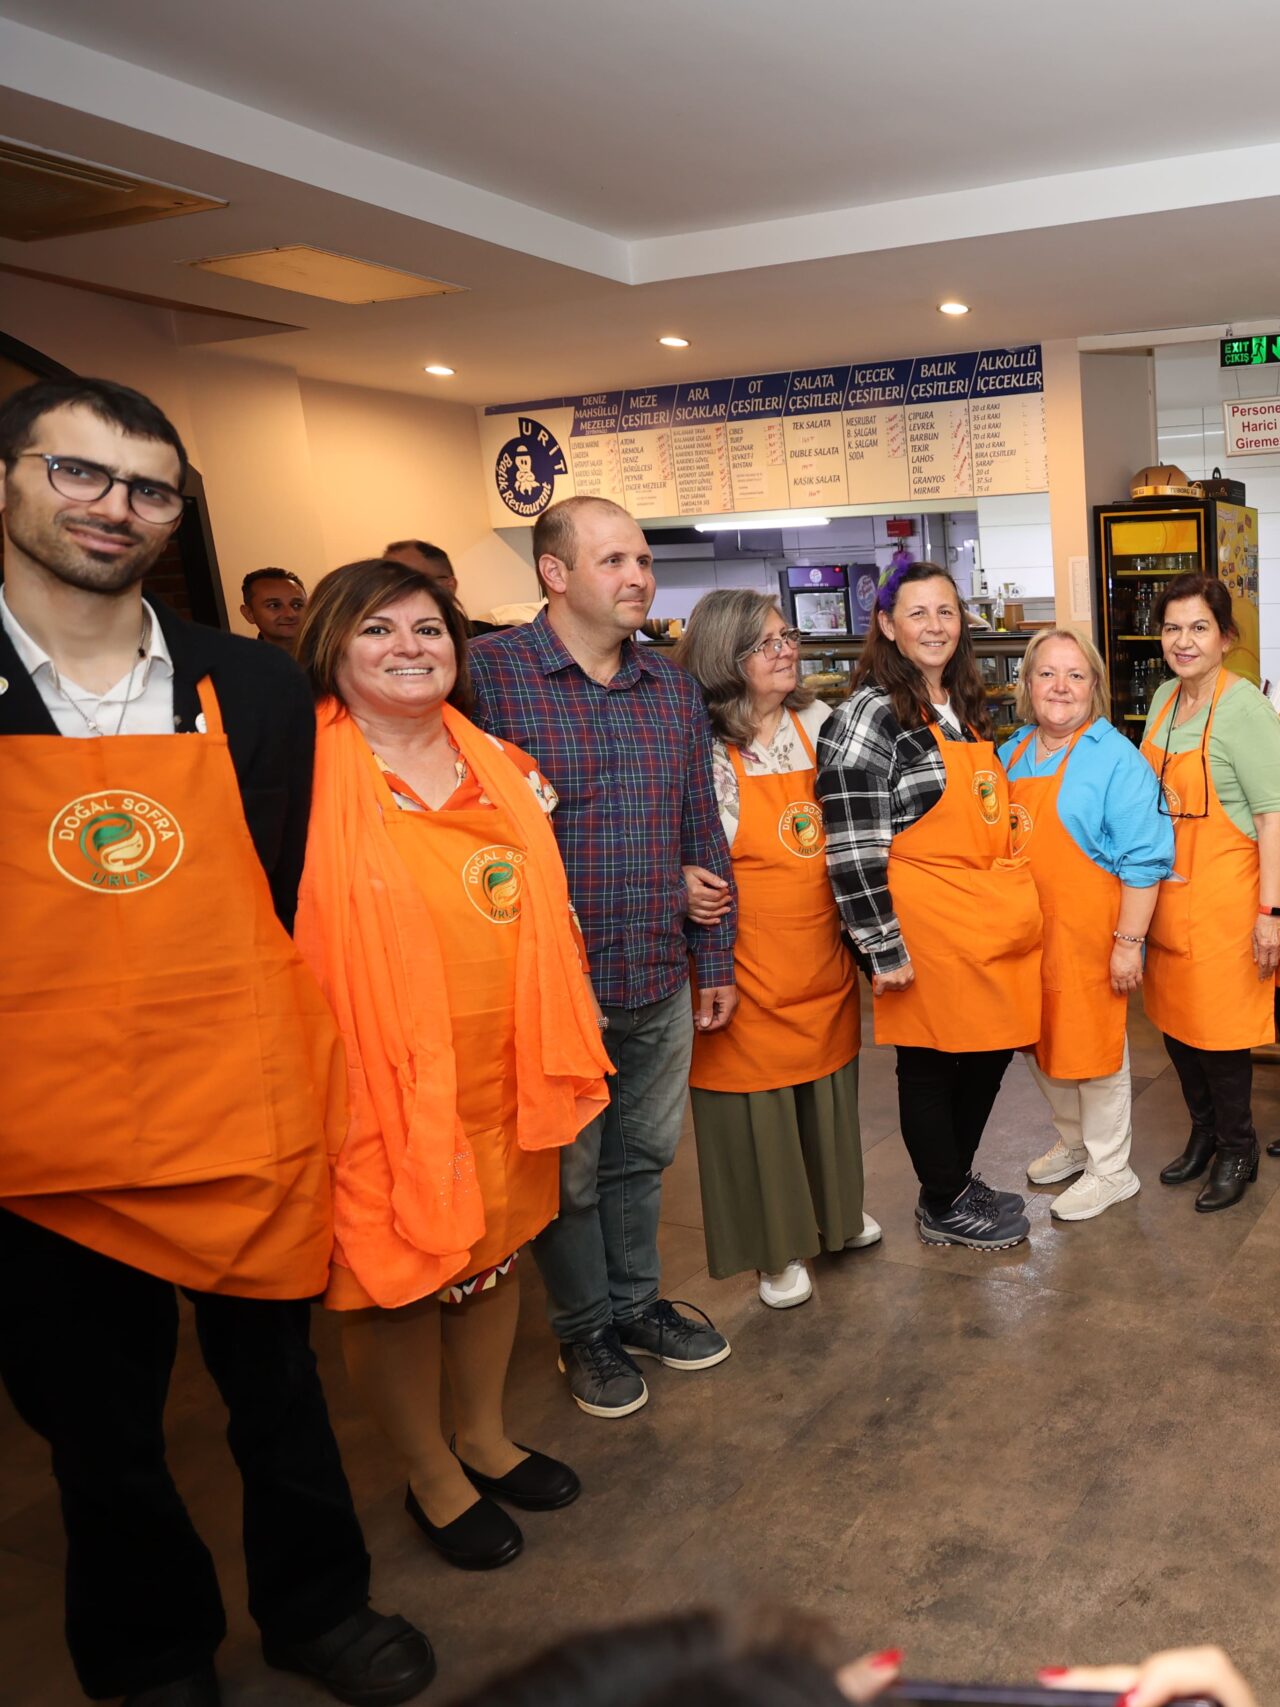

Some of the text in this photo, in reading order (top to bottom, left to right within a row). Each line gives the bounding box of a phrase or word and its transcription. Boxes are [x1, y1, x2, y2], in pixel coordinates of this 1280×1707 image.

[1225, 341, 1249, 353] EXIT
[979, 349, 1036, 372] ALKOLLÜ
[1225, 353, 1249, 365] ÇIKIŞ
[854, 367, 895, 386] İÇECEK
[921, 361, 956, 378] BALIK
[748, 380, 763, 394] OT
[793, 374, 834, 391] SALATA
[911, 378, 968, 400] ÇEŞİTLERİ
[977, 371, 1042, 393] İÇECEKLER
[583, 395, 606, 406] DENİZ
[630, 395, 657, 409] MEZE
[688, 387, 710, 402] ARA
[789, 391, 842, 412] ÇEŞİTLERİ
[848, 384, 904, 406] ÇEŞİTLERİ
[575, 404, 618, 419] MAHSÜLLÜ
[675, 403, 726, 421] SICAKLAR
[731, 395, 782, 416] ÇEŞİTLERİ
[580, 418, 615, 430] MEZELER
[622, 410, 669, 430] ÇEŞİTLERİ
[792, 419, 831, 430] TEK SALATA
[973, 414, 980, 422] 35
[1242, 419, 1277, 432] Harici
[909, 422, 935, 431] LEVREK
[910, 432, 939, 442] BARBUN
[790, 447, 839, 459] DUBLE SALATA
[849, 451, 864, 461] SODA
[912, 454, 934, 464] LAHOS
[815, 475, 840, 484] SALATA
[913, 475, 946, 484] GRANYOS
[503, 481, 552, 515] Restaurant
[58, 798, 175, 842] DOĞAL SOFRA
[469, 851, 501, 884] DOĞAL
[92, 870, 150, 886] URLA
